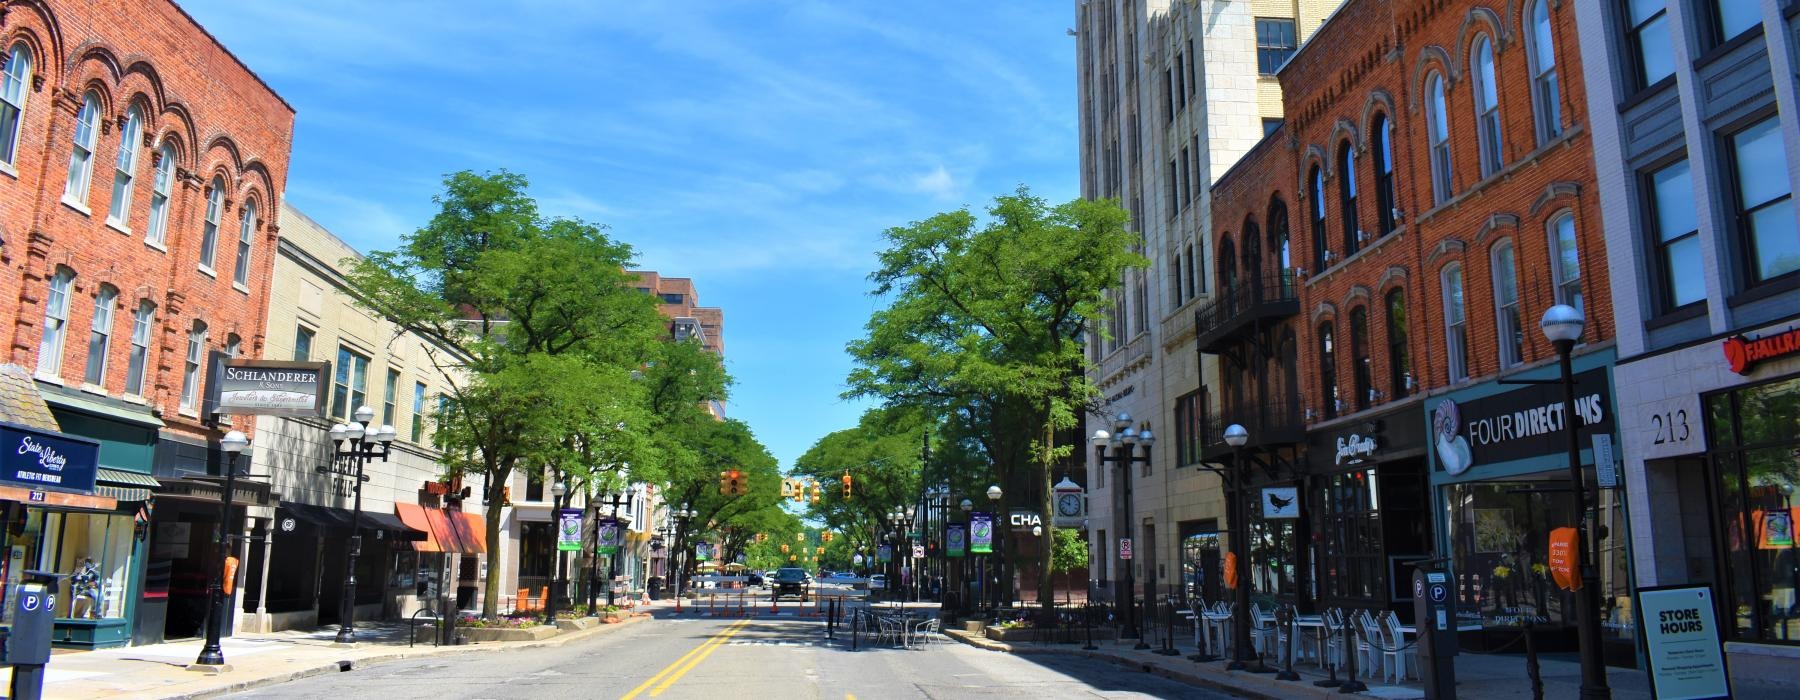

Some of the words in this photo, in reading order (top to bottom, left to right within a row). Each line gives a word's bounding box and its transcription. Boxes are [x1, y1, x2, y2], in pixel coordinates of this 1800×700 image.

[227, 367, 316, 383] SCHLANDERER
[1469, 414, 1514, 447] FOUR
[1515, 394, 1602, 438] DIRECTINS
[1651, 409, 1690, 445] 213
[19, 436, 43, 454] State
[40, 447, 66, 470] Liberty
[32, 492, 43, 500] 212
[1659, 608, 1700, 622] STORE
[1660, 621, 1703, 634] HOURS
